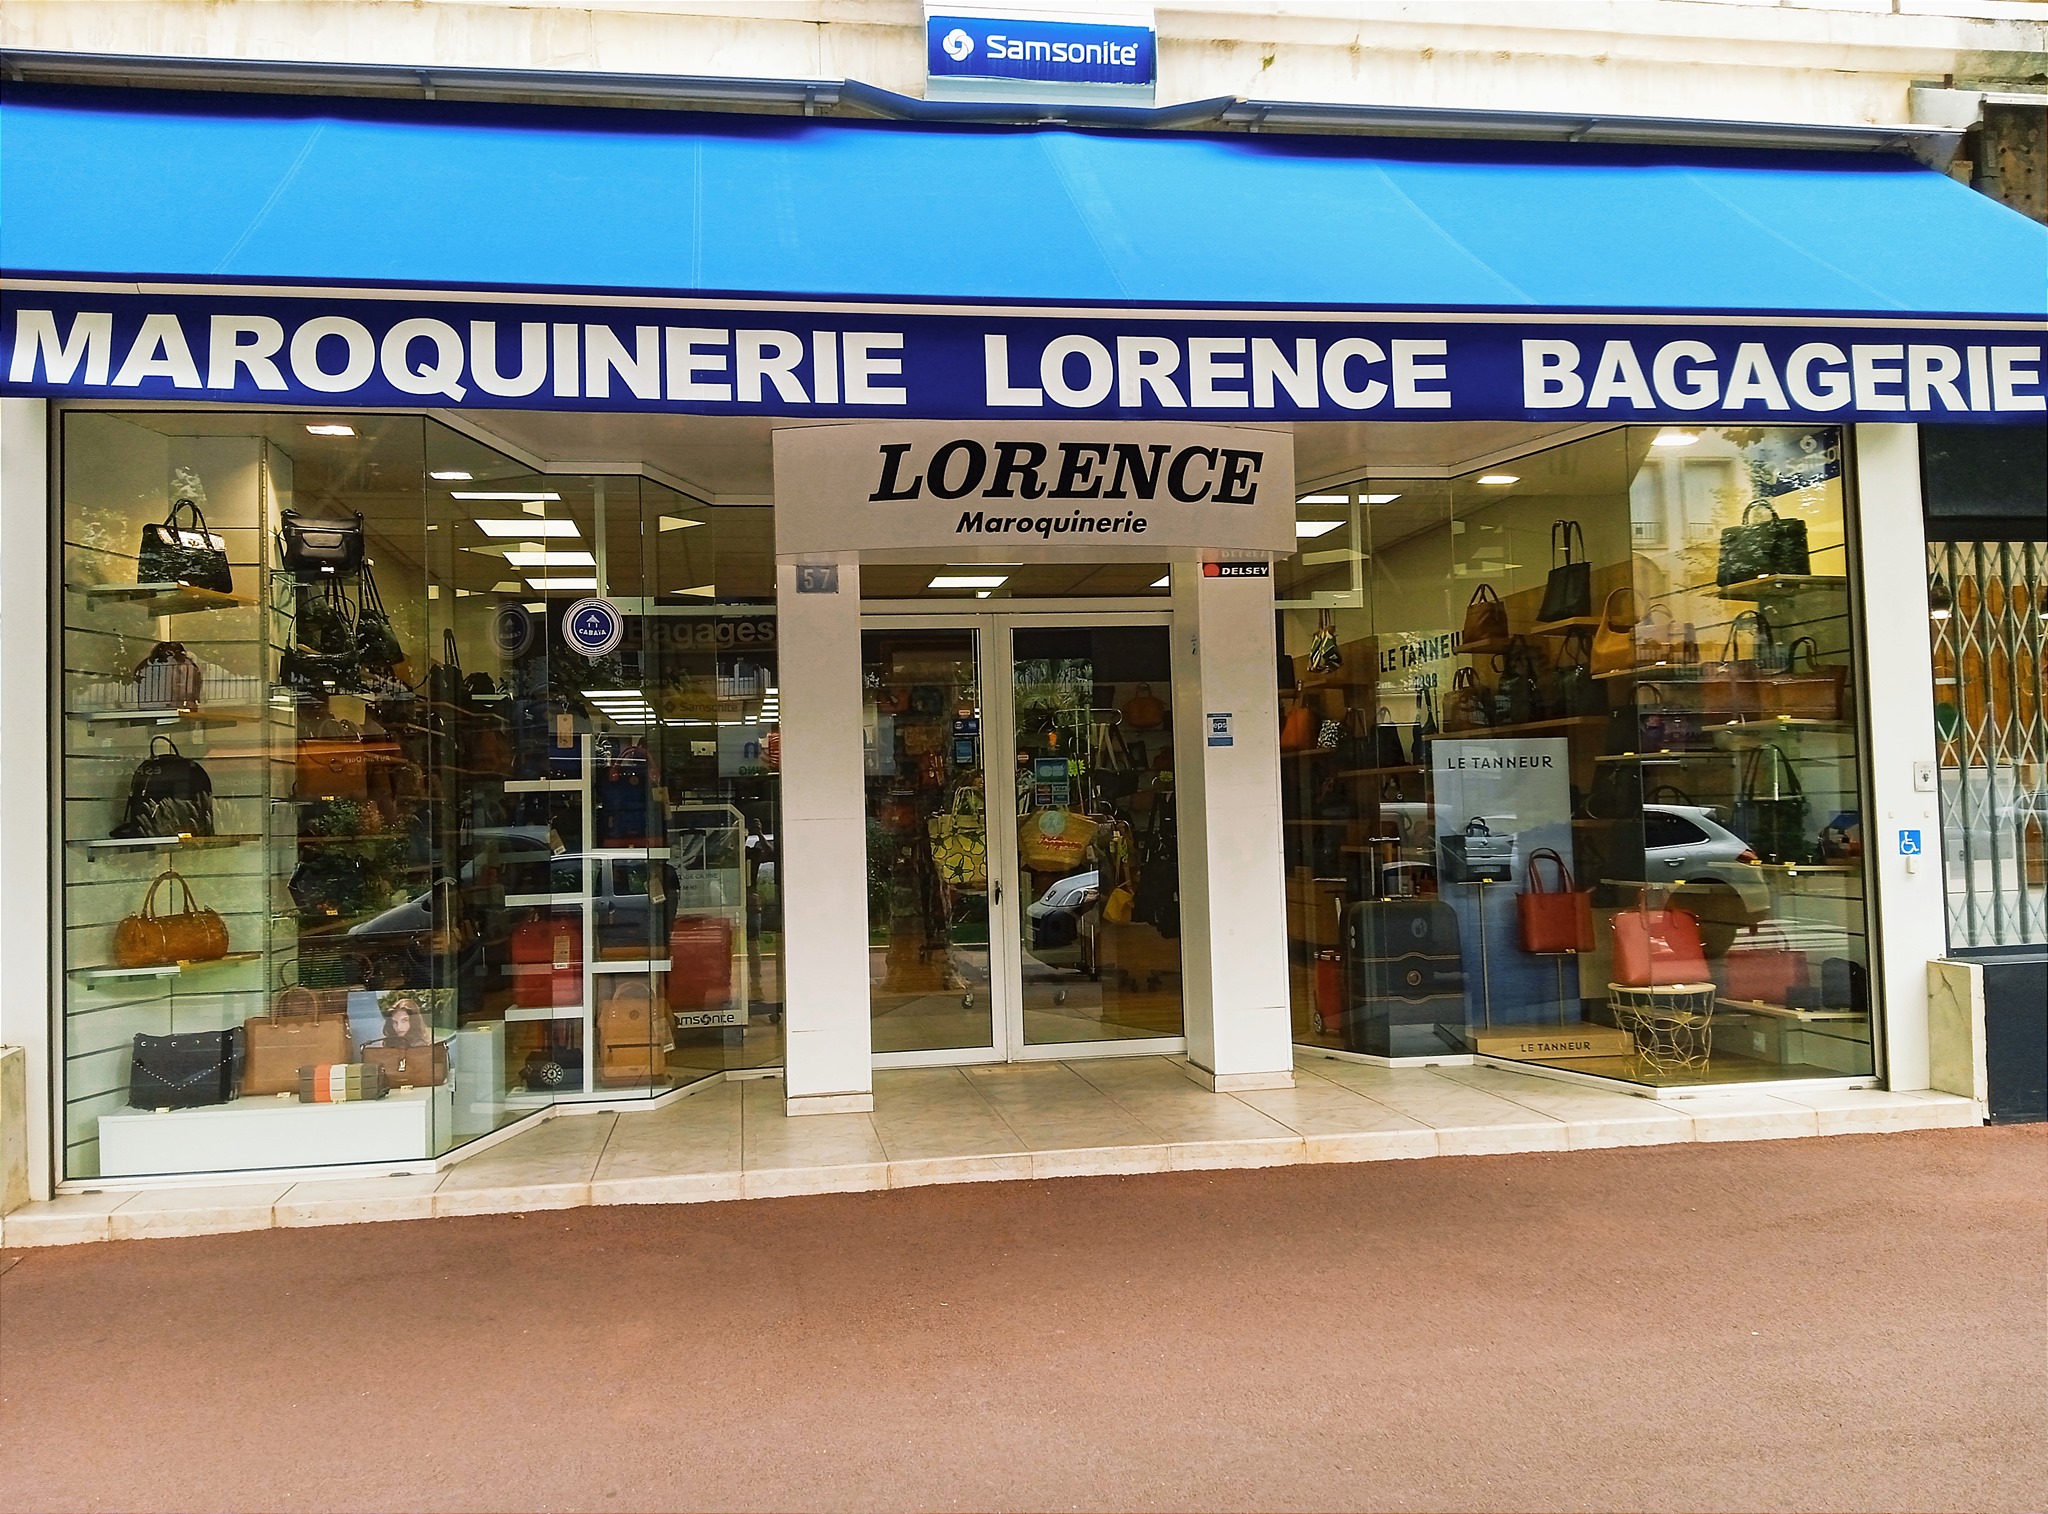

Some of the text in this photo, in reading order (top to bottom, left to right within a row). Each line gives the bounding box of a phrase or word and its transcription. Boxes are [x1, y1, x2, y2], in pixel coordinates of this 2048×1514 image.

[986, 35, 1138, 65] Samsonite
[8, 309, 2047, 412] MAROQUINERIE LORENCE BAGAGERIE
[868, 439, 1263, 505] LORENCE
[956, 510, 1148, 540] Maroquinerie
[804, 569, 831, 589] 57
[1222, 567, 1268, 575] DELSEY
[627, 620, 775, 649] Bagages
[1380, 629, 1464, 673] LE TANNEU
[1447, 756, 1553, 769] LE TANNEUR
[1520, 1041, 1591, 1052] LE TANNEUR
